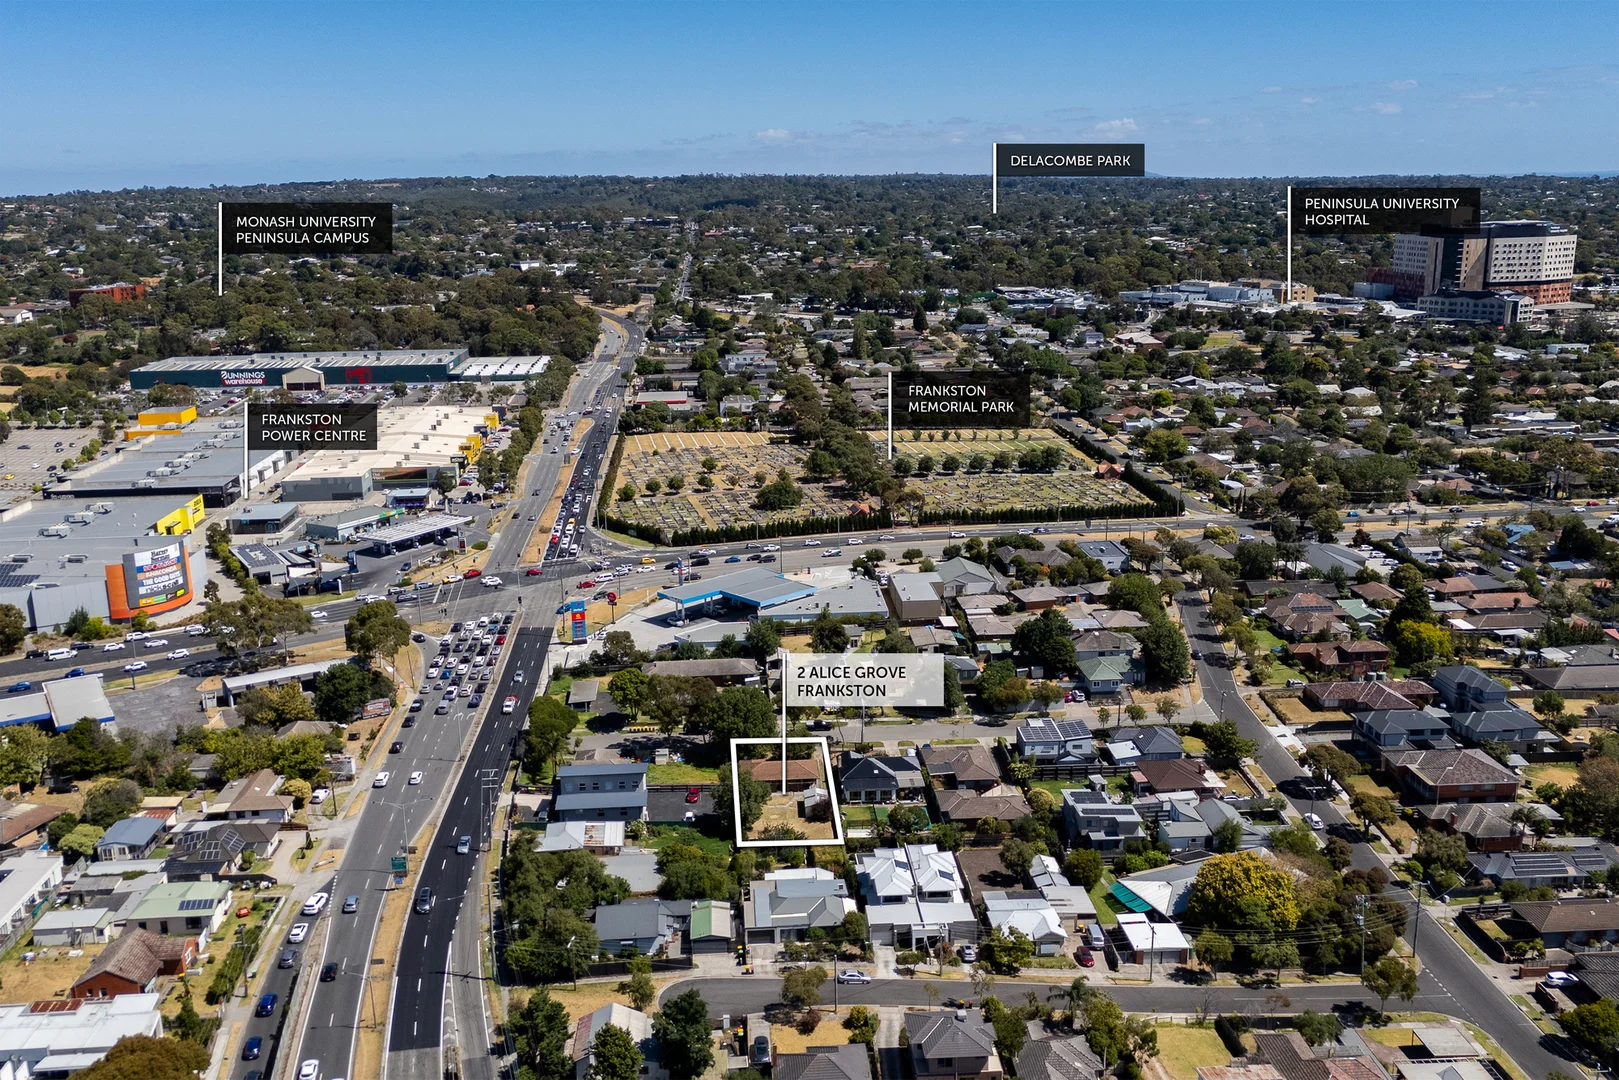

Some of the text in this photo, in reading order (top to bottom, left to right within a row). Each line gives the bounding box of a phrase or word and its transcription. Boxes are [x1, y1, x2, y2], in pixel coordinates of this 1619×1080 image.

[220, 371, 265, 379] BUNNINGS
[143, 578, 154, 586] THE
[154, 575, 170, 584] GOOD
